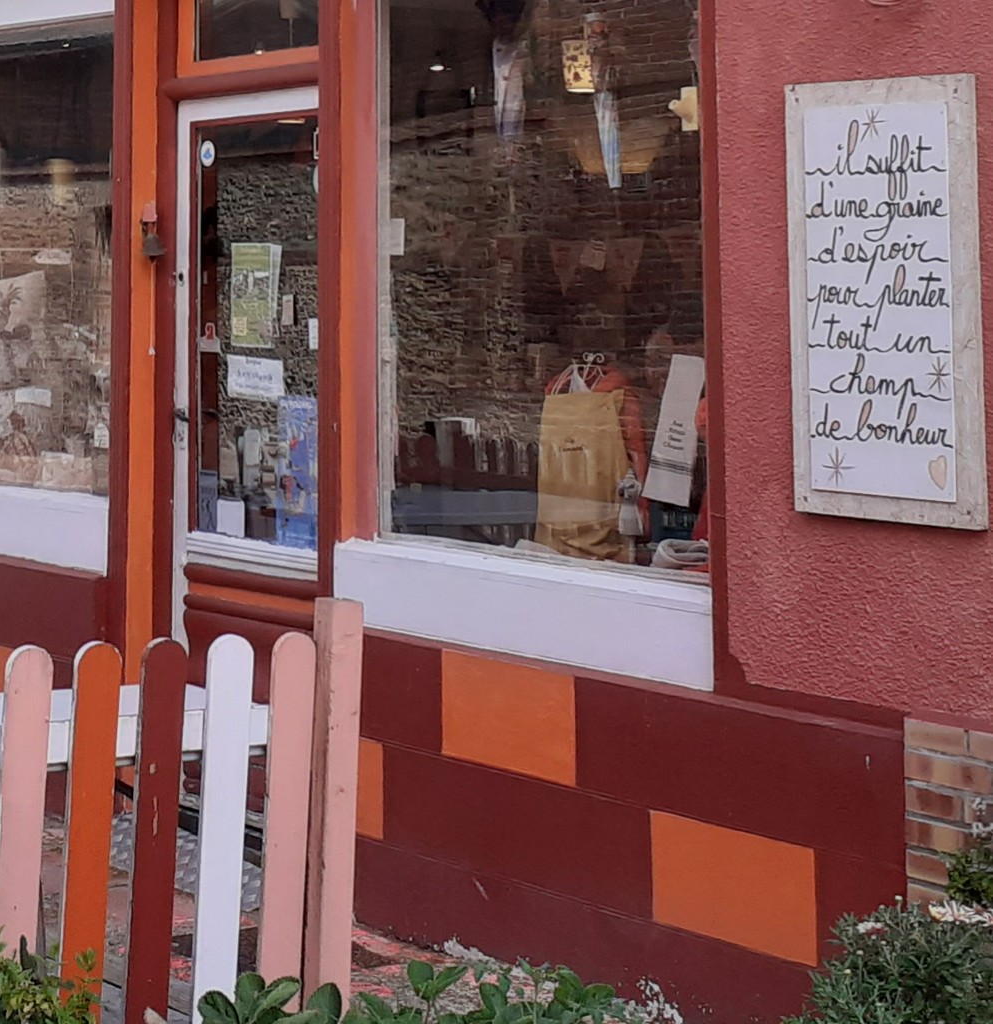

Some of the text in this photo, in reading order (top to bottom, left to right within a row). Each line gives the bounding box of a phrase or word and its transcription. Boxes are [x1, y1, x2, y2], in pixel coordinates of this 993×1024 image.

[829, 119, 934, 201] il suffit
[806, 180, 948, 242] d'une graine
[816, 225, 939, 285] d'espoir
[808, 264, 950, 332] pour planter
[821, 313, 937, 354] tout un
[829, 353, 920, 420] champ
[812, 399, 954, 449] de bonheur
